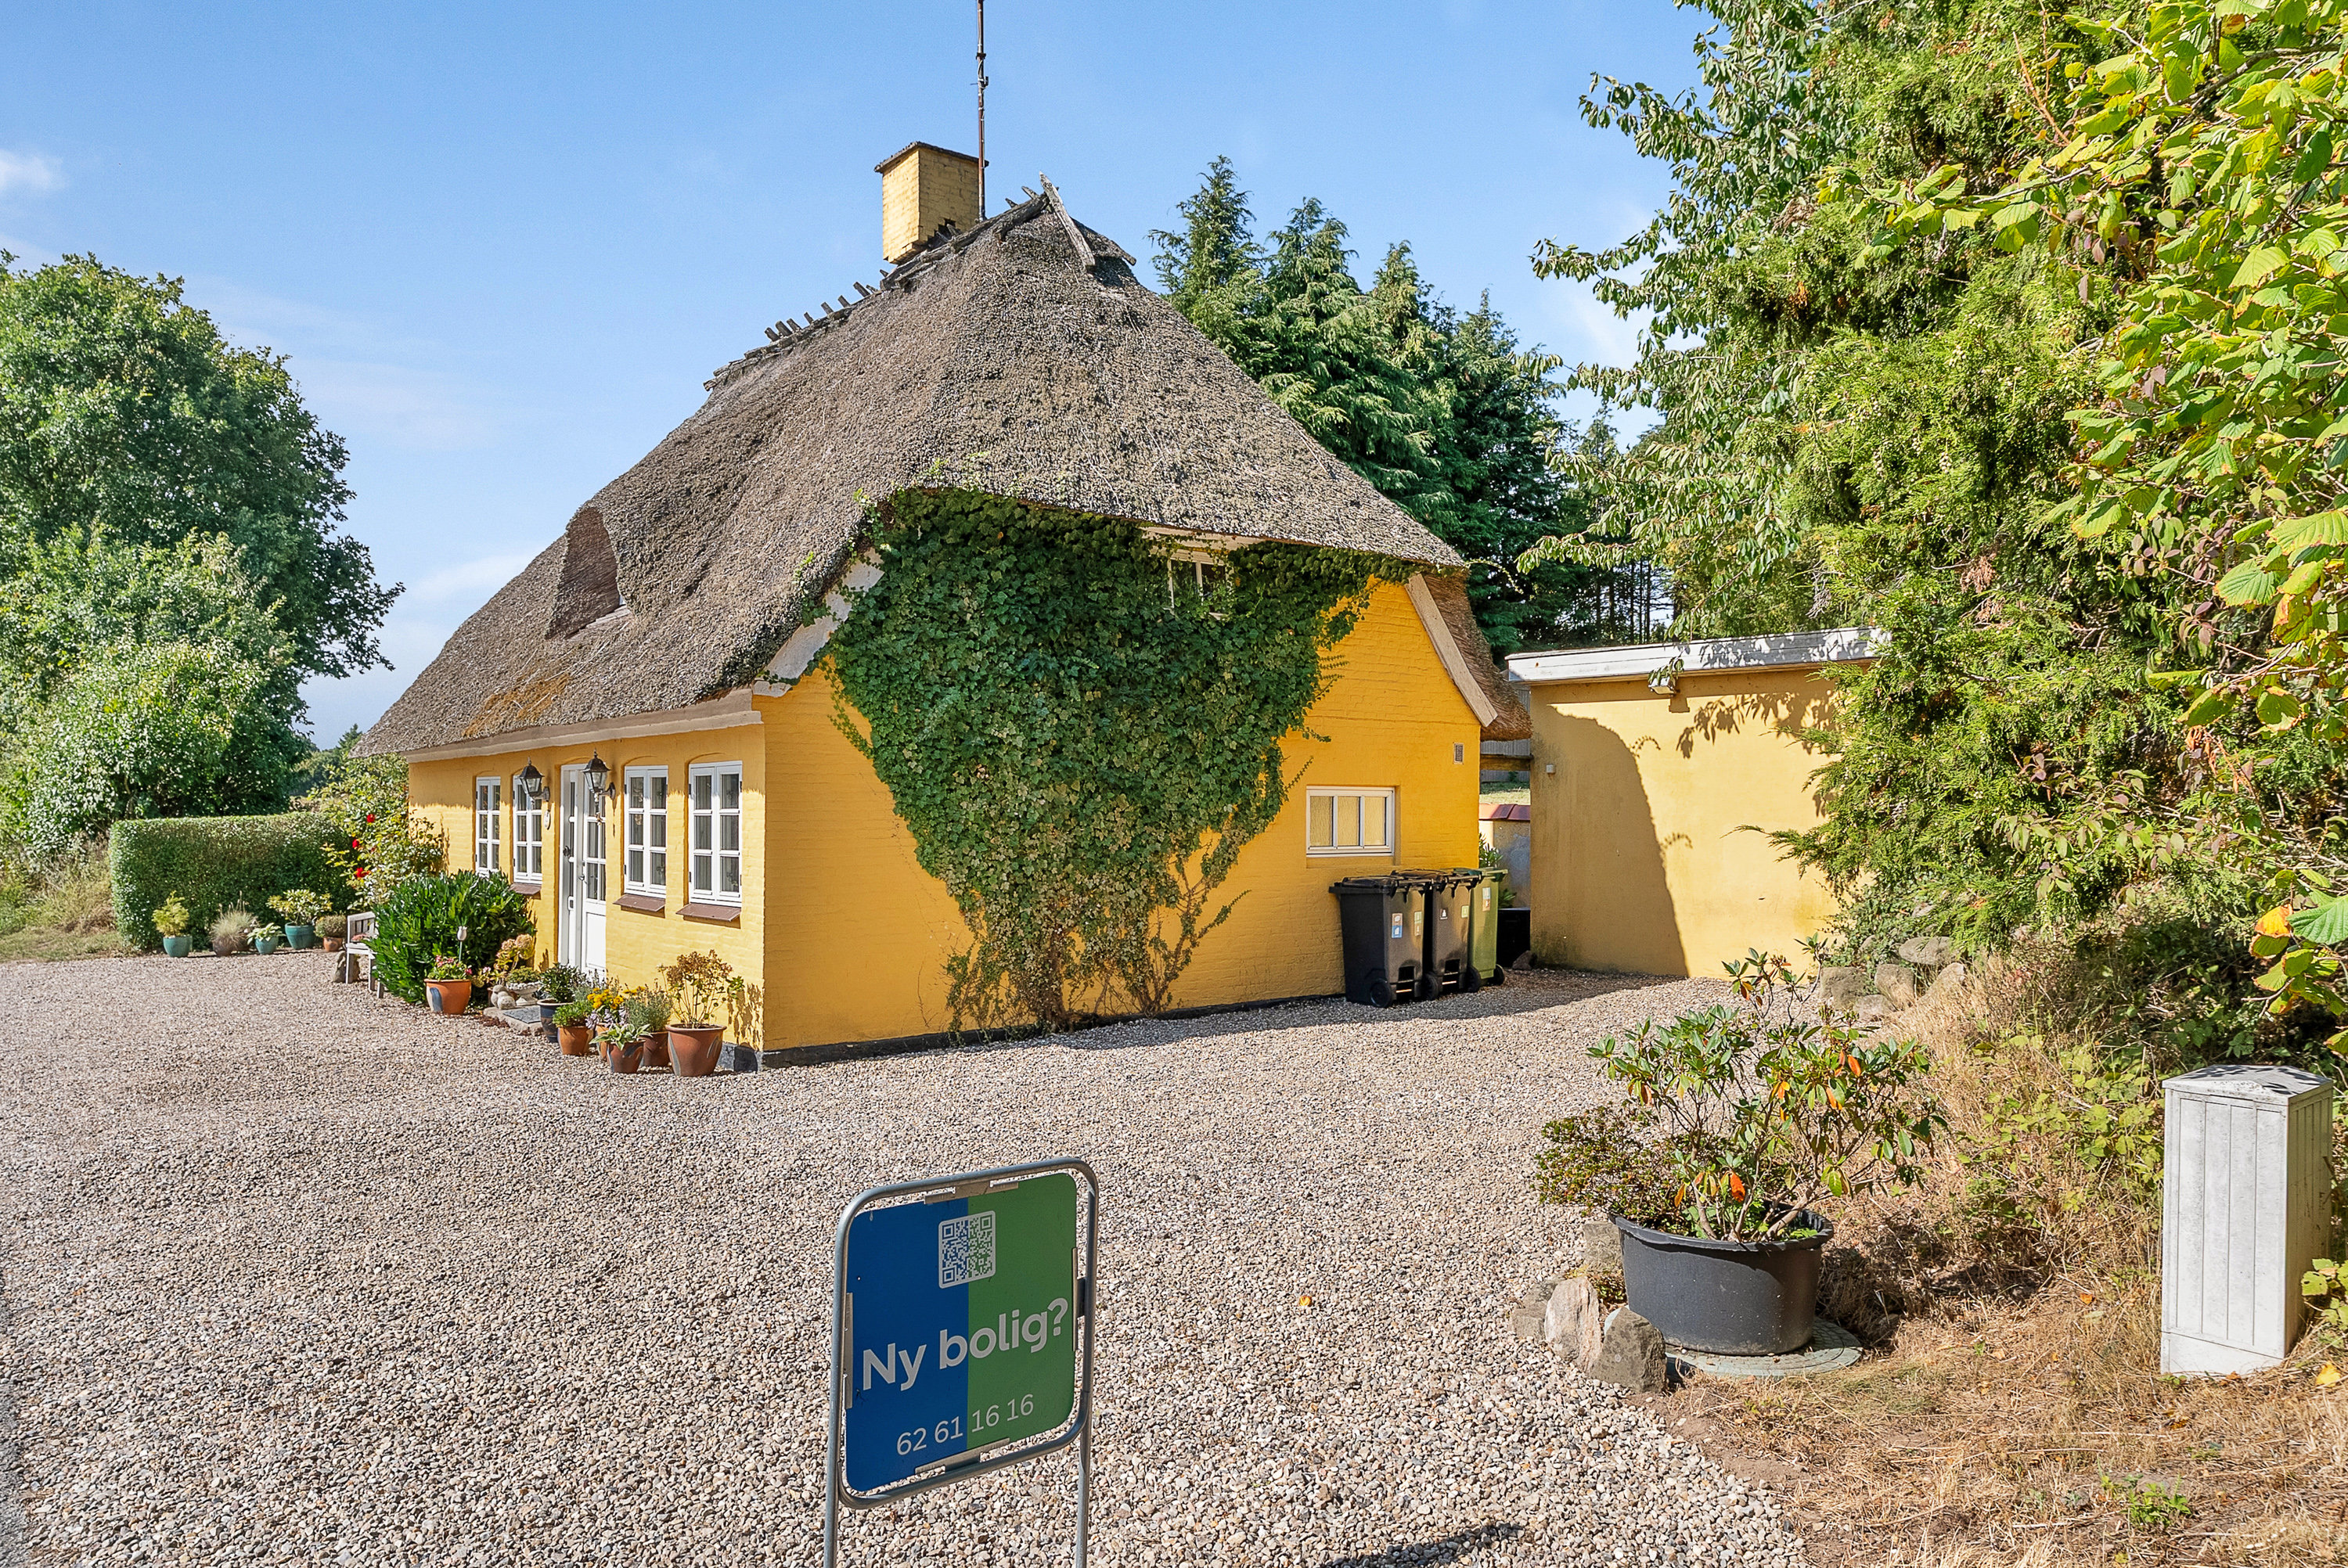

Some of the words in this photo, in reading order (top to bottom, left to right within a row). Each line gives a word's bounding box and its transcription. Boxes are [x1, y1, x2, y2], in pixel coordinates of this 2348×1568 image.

[862, 1343, 927, 1391] Ny
[938, 1297, 1068, 1369] bolig?
[897, 1427, 927, 1455] 62
[935, 1416, 963, 1444] 61
[971, 1404, 1000, 1433] 16
[1007, 1394, 1035, 1422] 16
